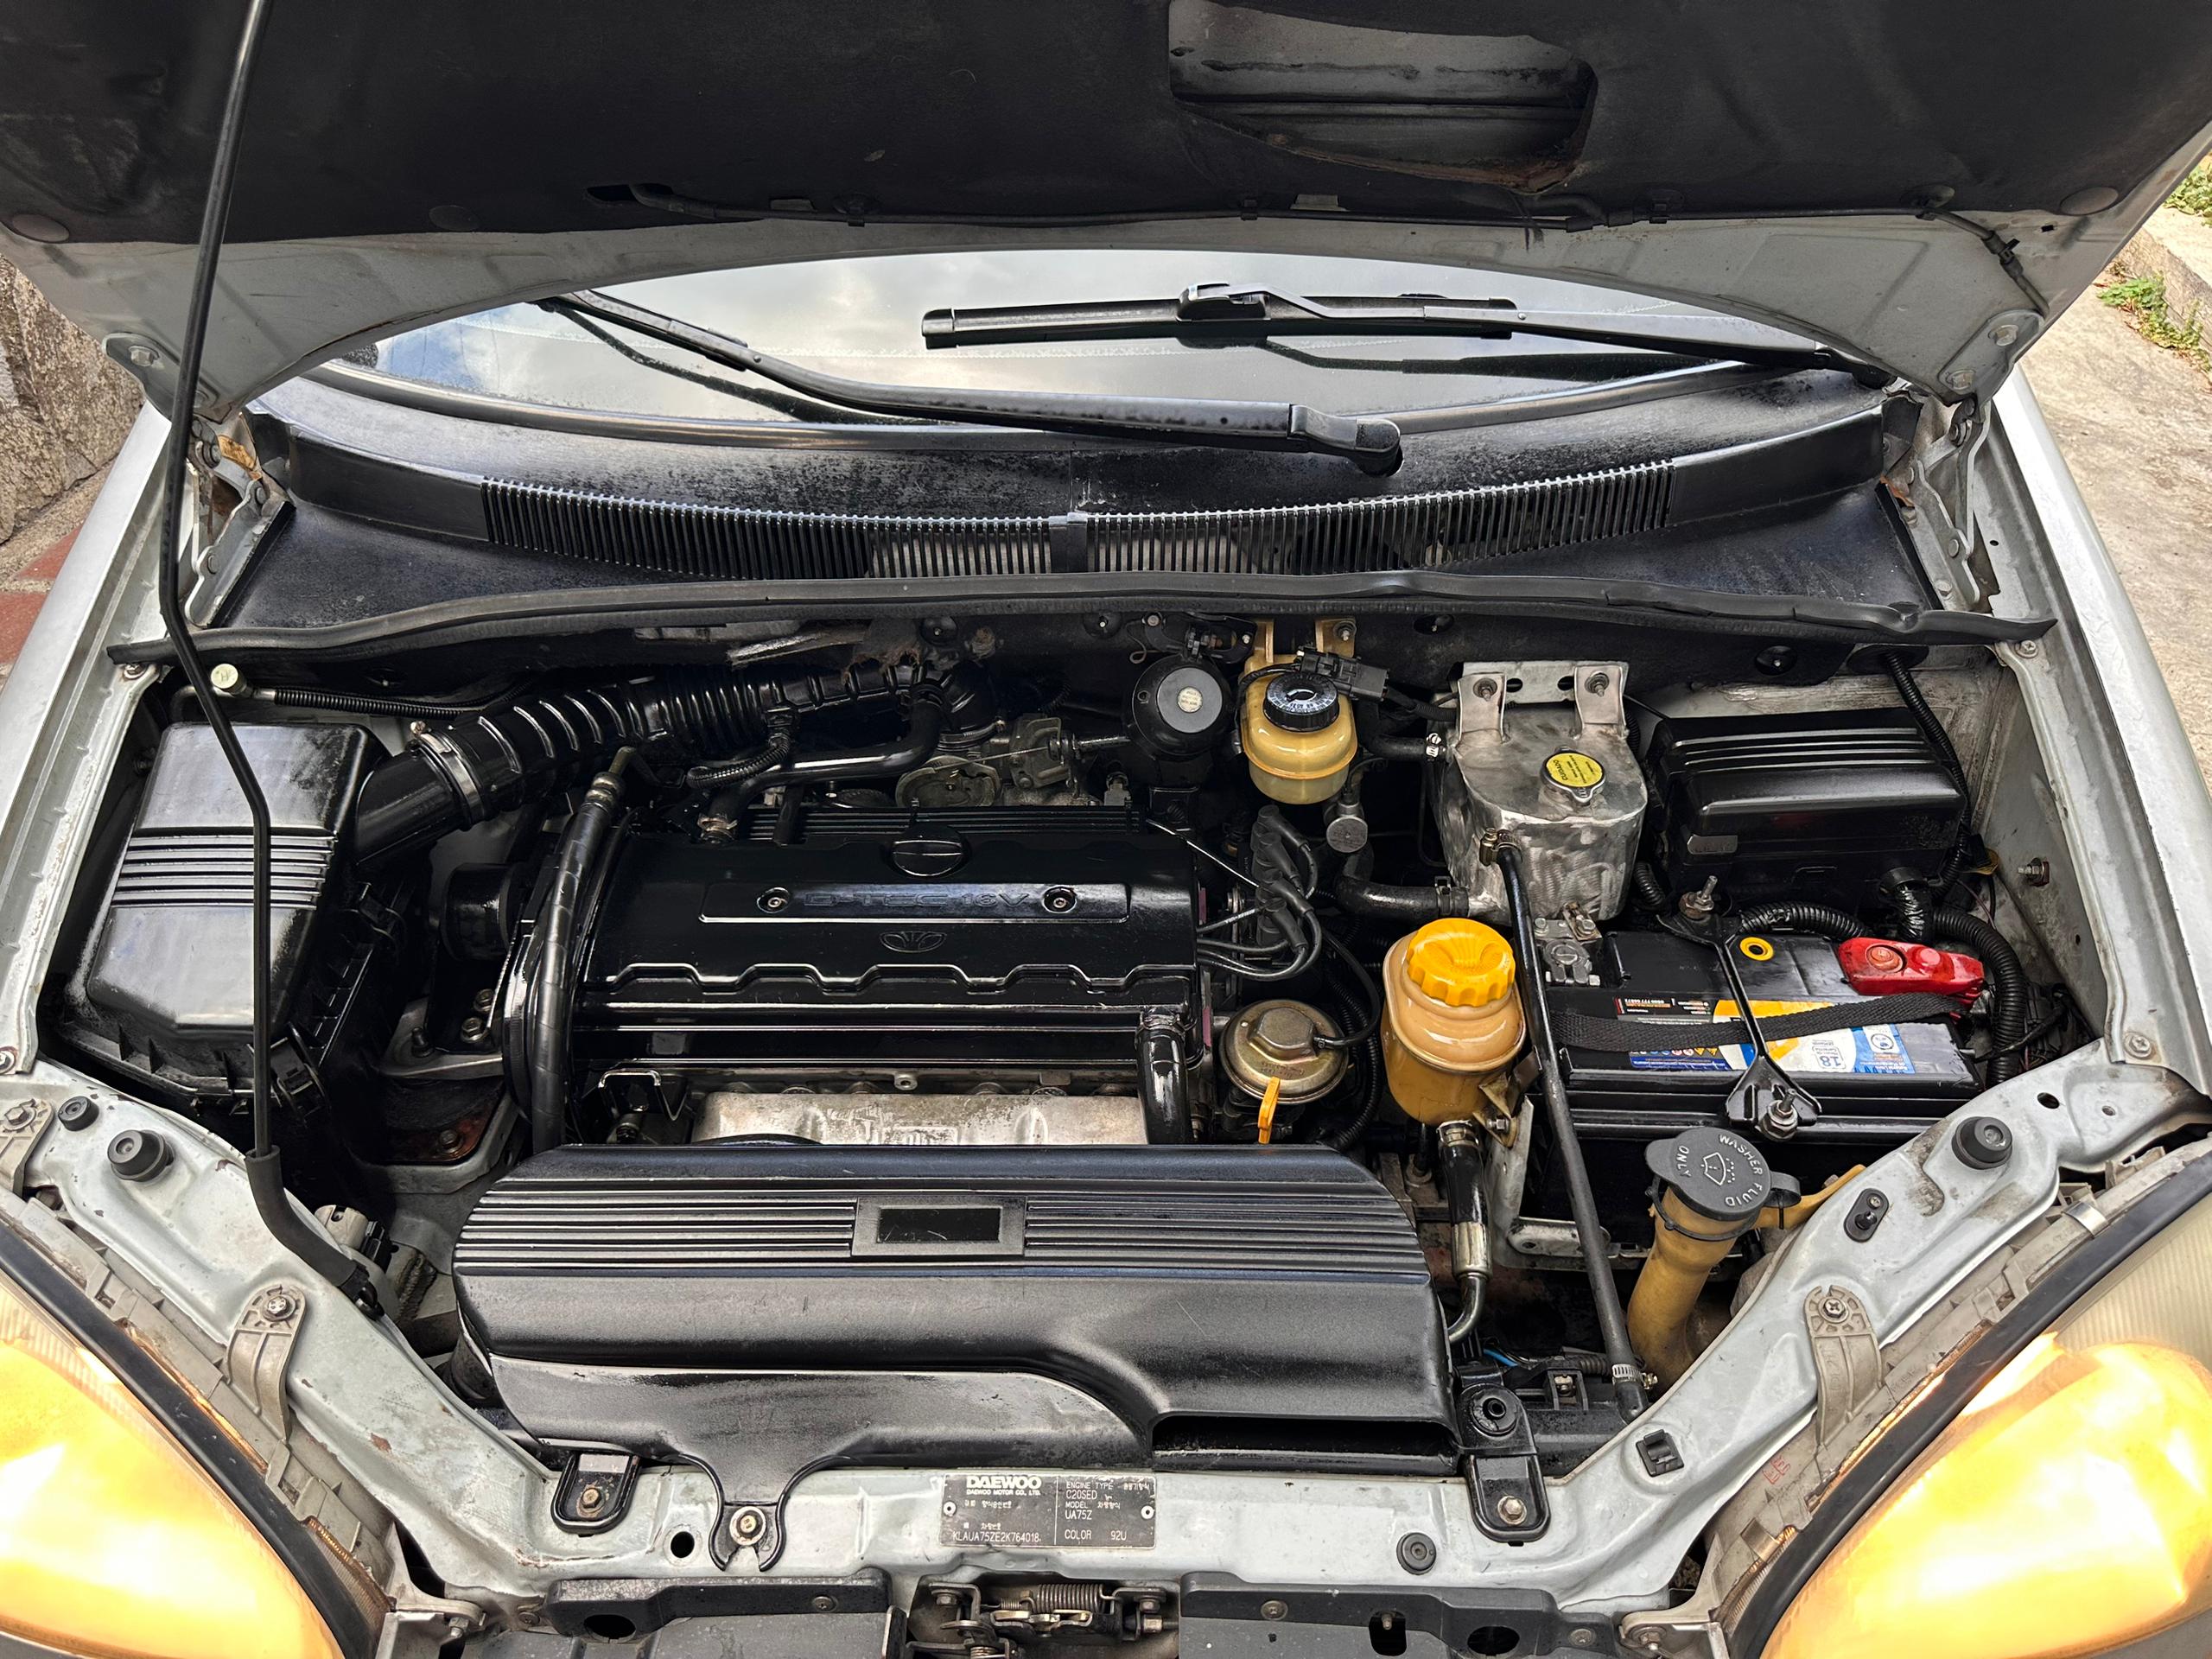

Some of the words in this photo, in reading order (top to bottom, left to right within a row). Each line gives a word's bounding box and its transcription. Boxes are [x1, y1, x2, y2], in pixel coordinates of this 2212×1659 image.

[804, 893, 949, 906] D-TEC
[961, 893, 1030, 907] 16V
[1819, 1056, 1841, 1067] 18
[1675, 1145, 1692, 1177] ONLY
[1719, 1134, 1764, 1176] WASHER
[1725, 1182, 1764, 1206] FLUID
[966, 1476, 1042, 1489] DAEWOO
[1065, 1490, 1098, 1499] C20SED
[1065, 1510, 1092, 1520] UA75Z
[1064, 1529, 1092, 1540] COLOR
[1111, 1530, 1127, 1541] 92U
